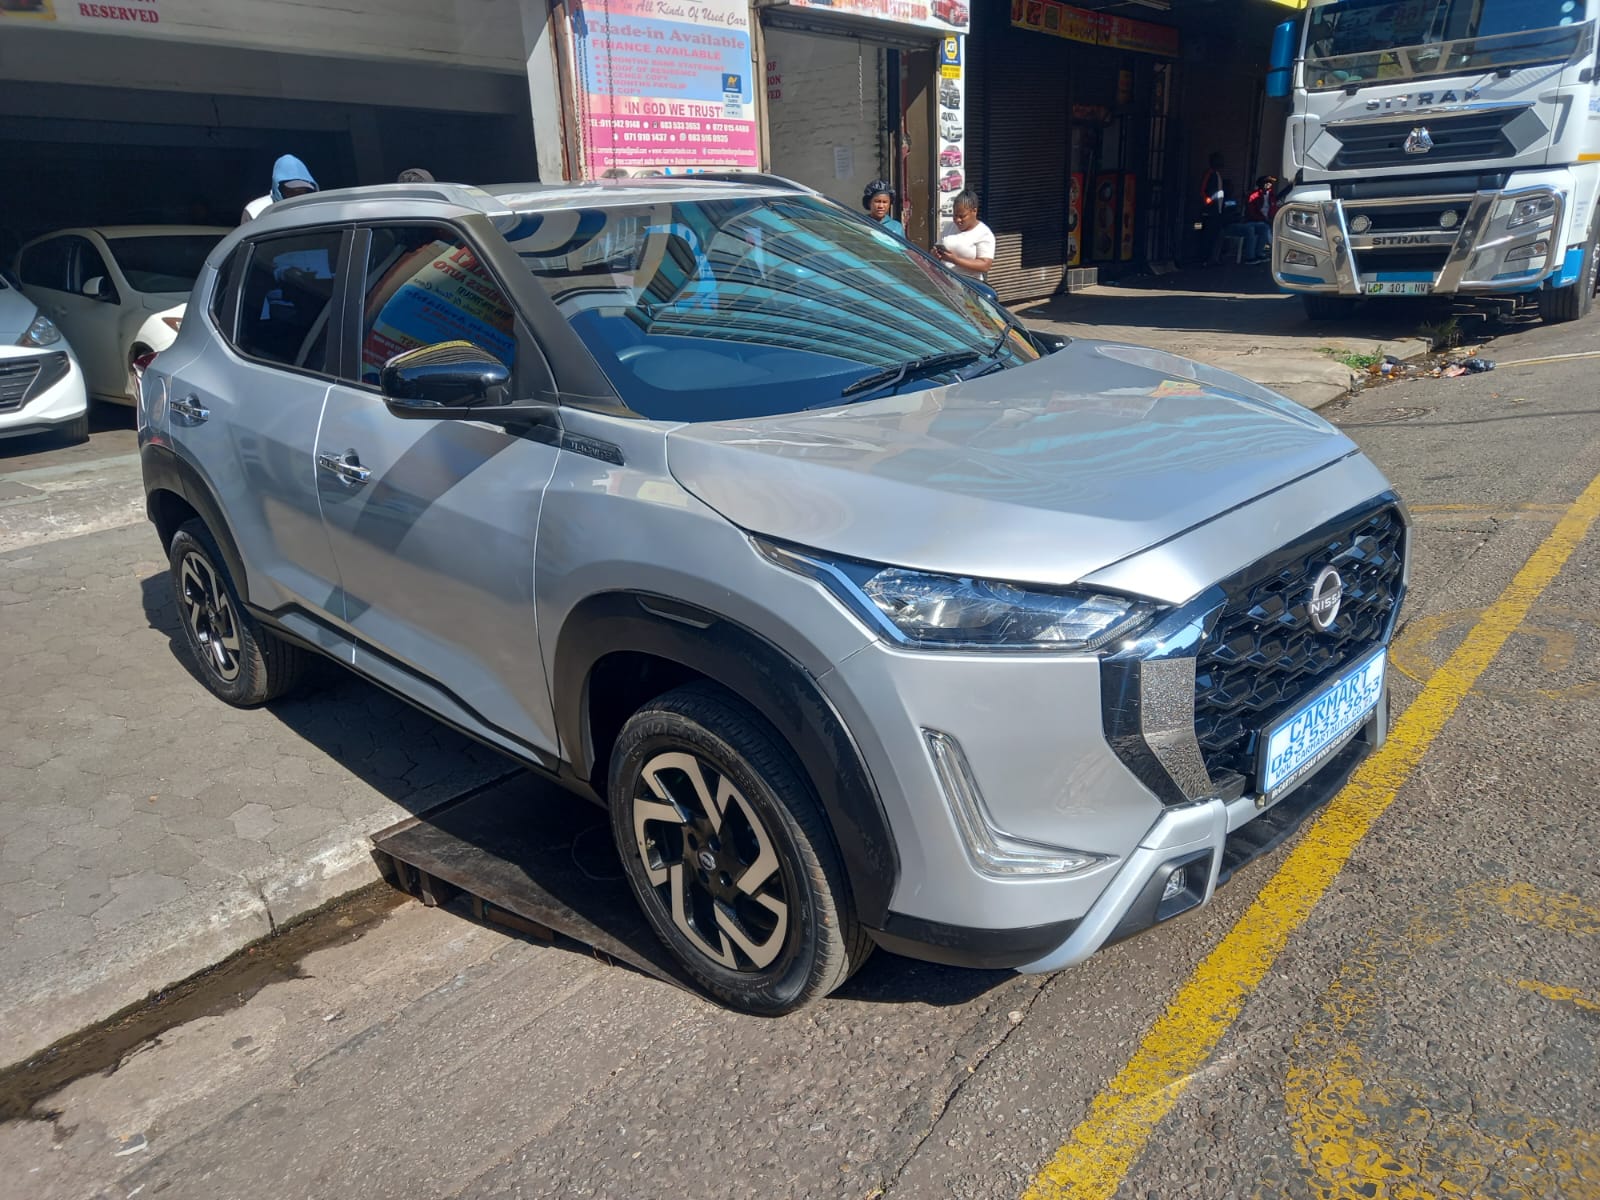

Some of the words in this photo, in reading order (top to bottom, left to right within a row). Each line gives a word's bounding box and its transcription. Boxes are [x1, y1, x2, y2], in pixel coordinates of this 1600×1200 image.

[78, 3, 160, 23] RESERVED
[636, 0, 654, 13] All
[657, 1, 684, 17] Kinds
[687, 6, 699, 22] Of
[701, 8, 726, 22] Used
[727, 12, 748, 26] Cars
[587, 19, 665, 40] Trade-in
[670, 28, 745, 49] Available
[592, 38, 652, 54] FINANCE
[656, 44, 722, 60] AVAILABLE
[643, 102, 666, 115] GOD
[669, 103, 685, 115] WE
[1365, 88, 1480, 111] SITRAK
[1372, 234, 1431, 246] SITRAK
[1390, 283, 1406, 293] 101
[1289, 665, 1371, 743] CARMART
[1271, 736, 1305, 774] 083
[1309, 709, 1340, 742] 533
[1344, 675, 1380, 715] 3653
